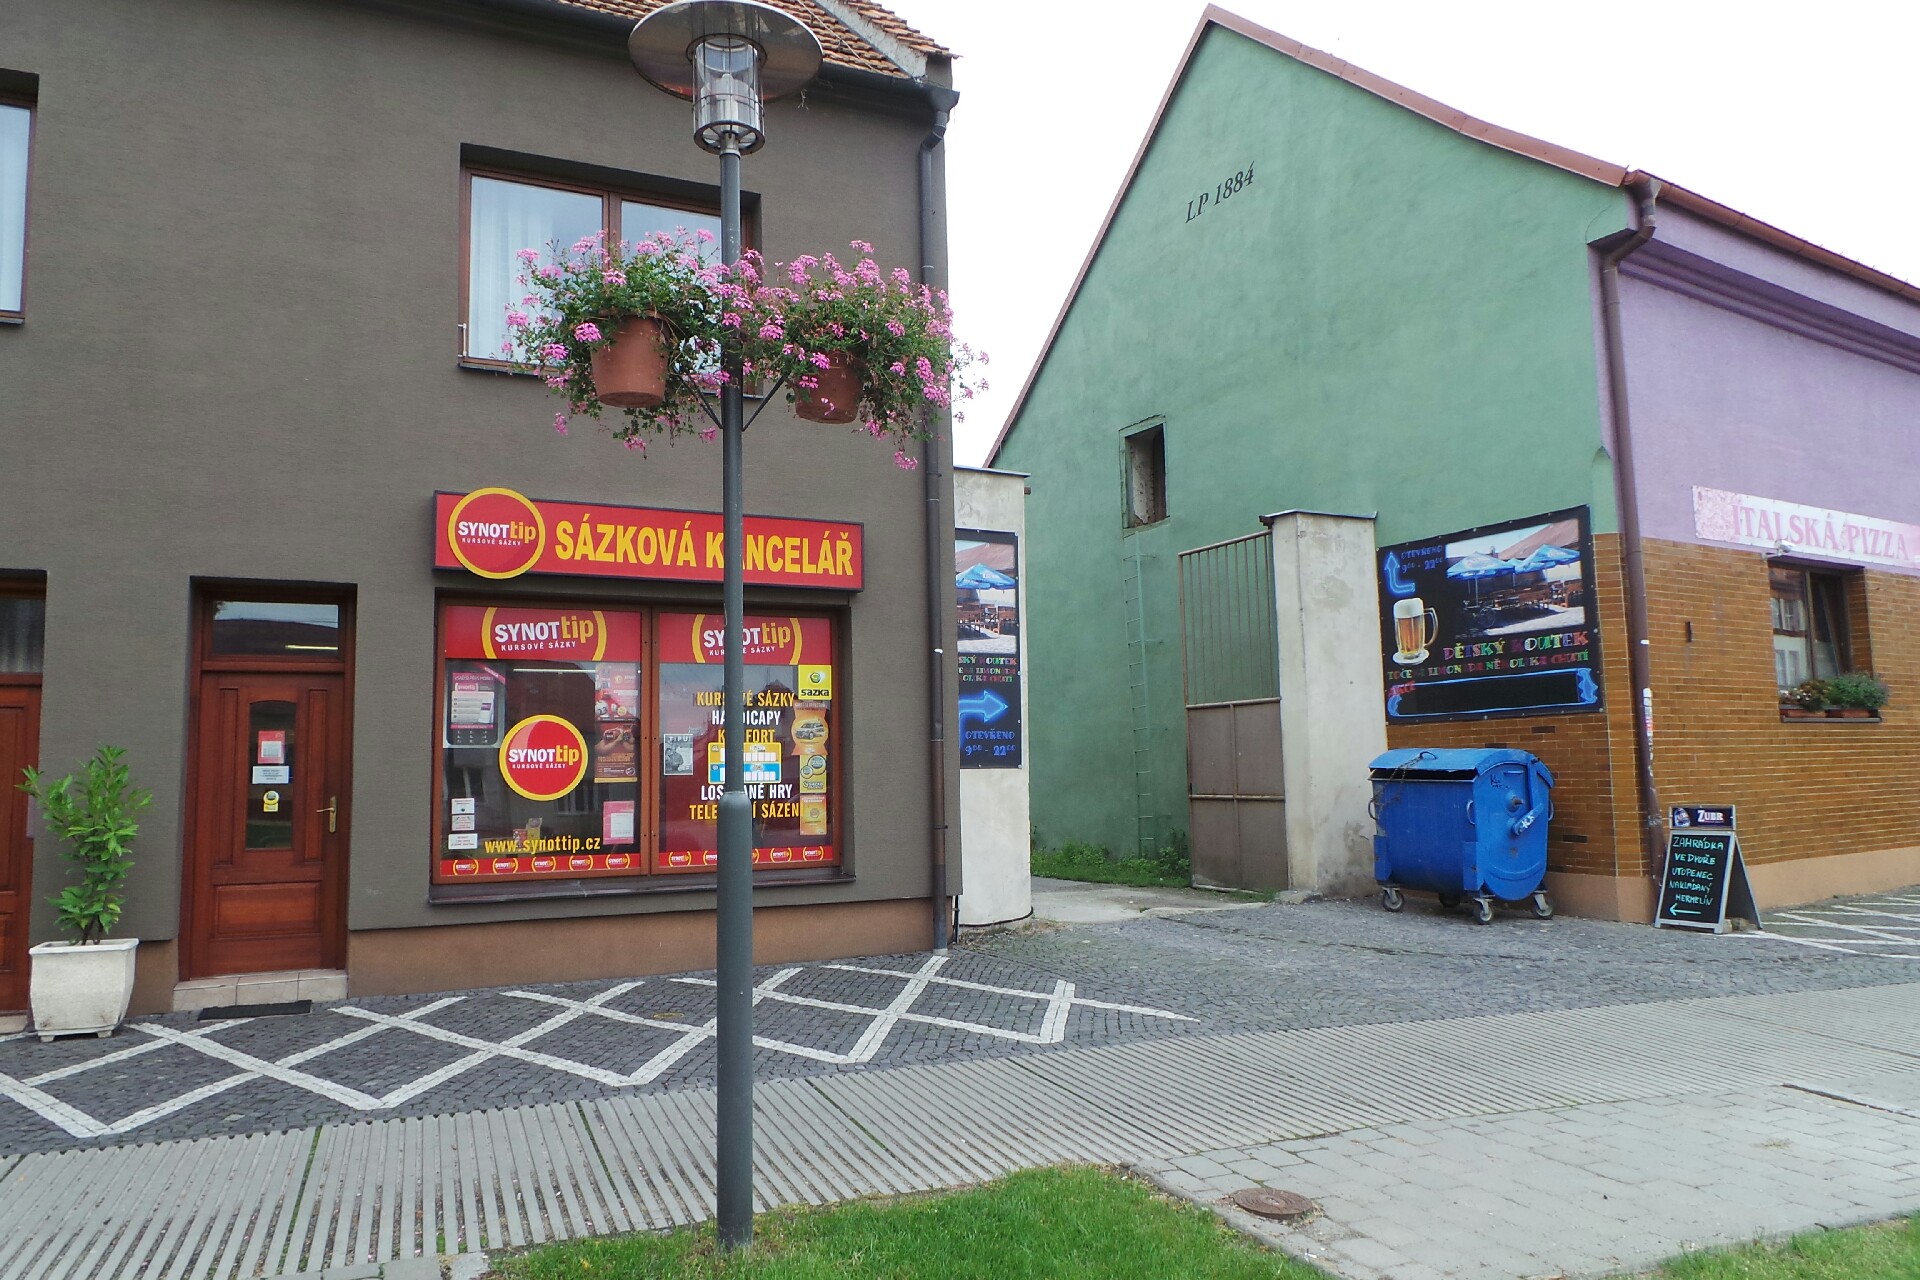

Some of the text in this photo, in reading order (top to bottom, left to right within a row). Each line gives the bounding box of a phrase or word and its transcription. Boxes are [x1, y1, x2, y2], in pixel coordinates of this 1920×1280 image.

[1185, 160, 1255, 224] LP 1884
[458, 521, 537, 543] SYNOTtip
[1732, 505, 1909, 560] ITALSKÁ PIZZA
[462, 537, 496, 545] KURSOVÉ
[555, 513, 854, 576] SÁZKOVÁ KNCELÁŘ
[1401, 545, 1442, 559] OTEVŘENO
[494, 615, 594, 643] SYNOTtip
[703, 622, 791, 648] SYOTtip
[501, 640, 577, 652] KURSOVÉ SÁZKY
[1511, 631, 1589, 652] KOUTEK
[709, 645, 776, 656] KURÉ SÁZKY
[1387, 668, 1425, 680] TOČE
[1428, 663, 1484, 676] LIMONDA
[696, 690, 753, 706] KURÉ
[757, 690, 795, 706] SÁZKY
[711, 710, 781, 725] HAICAPY
[718, 729, 775, 743] KFORT
[965, 728, 1015, 740] OTEVŘENO
[508, 745, 580, 765] SYNOTtip
[701, 783, 765, 800] LOSNÉ
[769, 784, 793, 799] HRY
[689, 801, 800, 820] TELEÍ SÁZEN
[484, 835, 601, 854] www.synottip.cz
[1672, 837, 1724, 850] ZAHRÁDKA
[1672, 867, 1714, 880] UTOPENEC
